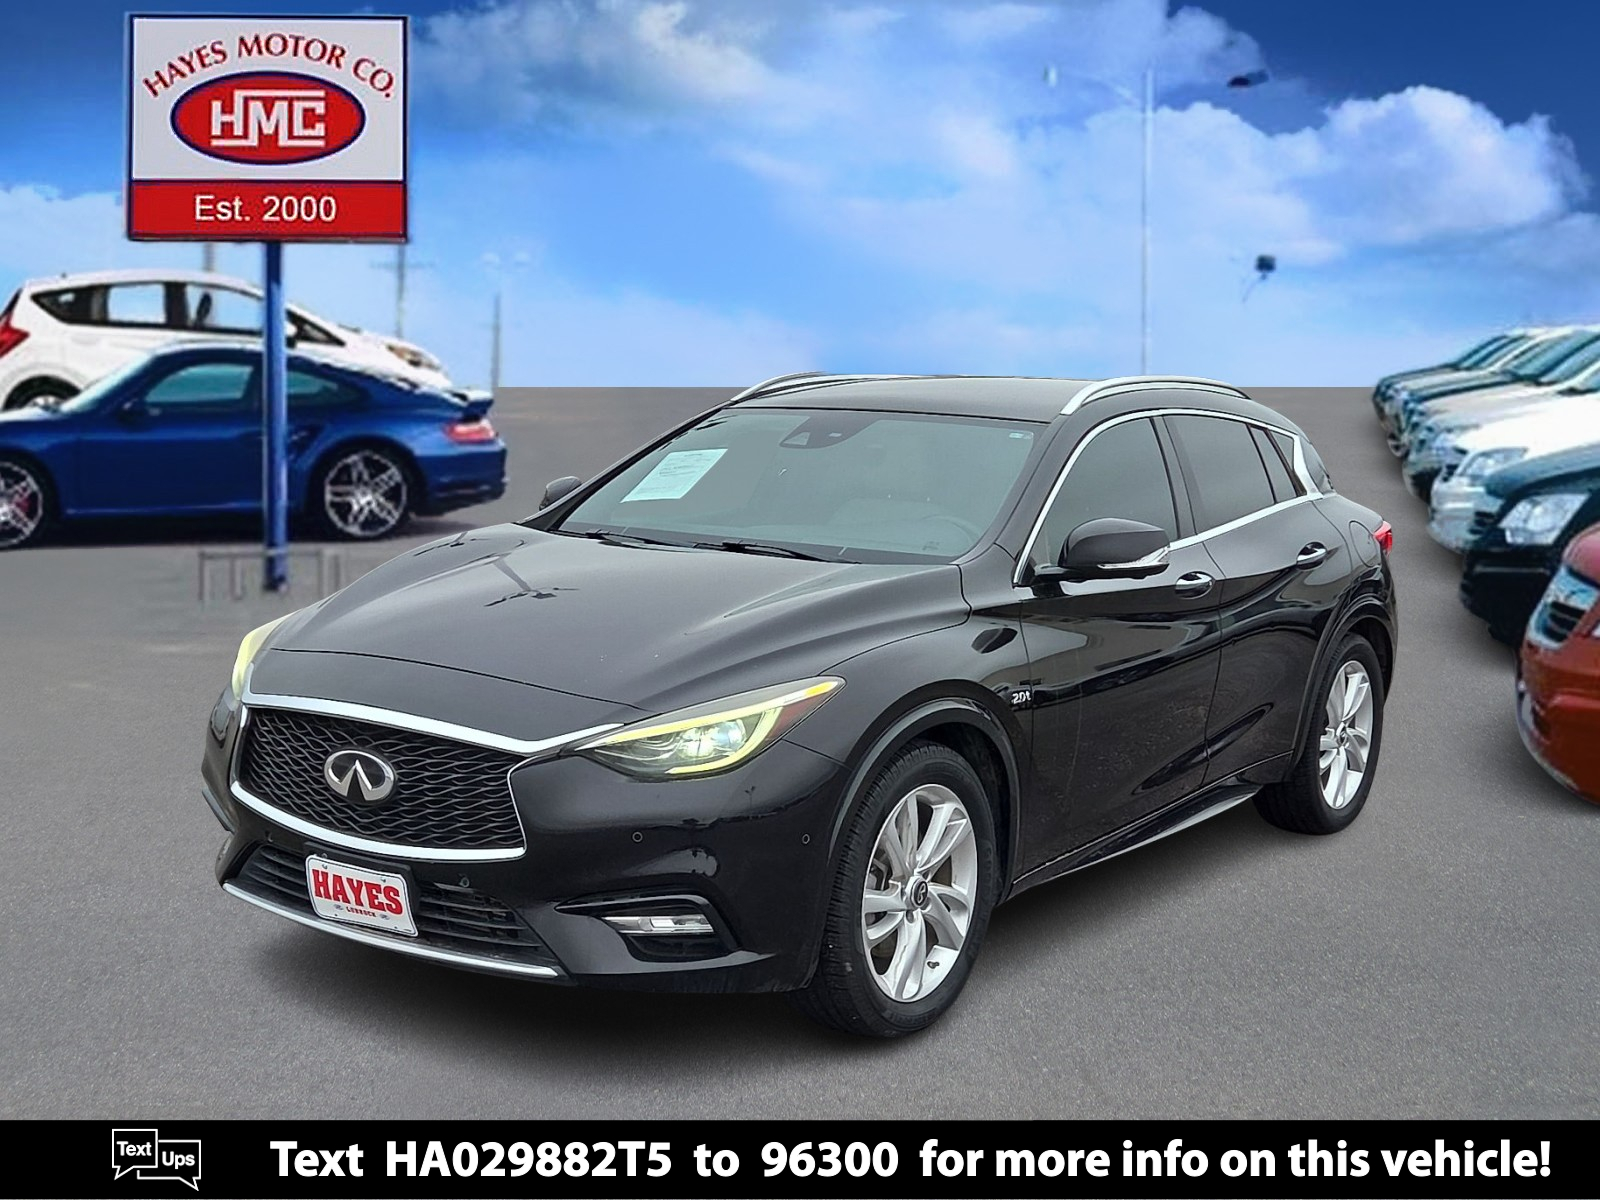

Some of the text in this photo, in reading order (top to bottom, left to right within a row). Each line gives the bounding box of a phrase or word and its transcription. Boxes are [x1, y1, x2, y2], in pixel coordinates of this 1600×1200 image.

[143, 33, 395, 99] HAYES MOTOR CO.
[210, 89, 326, 147] HMC
[194, 195, 337, 222] Est. 2000
[312, 868, 403, 915] HAYES
